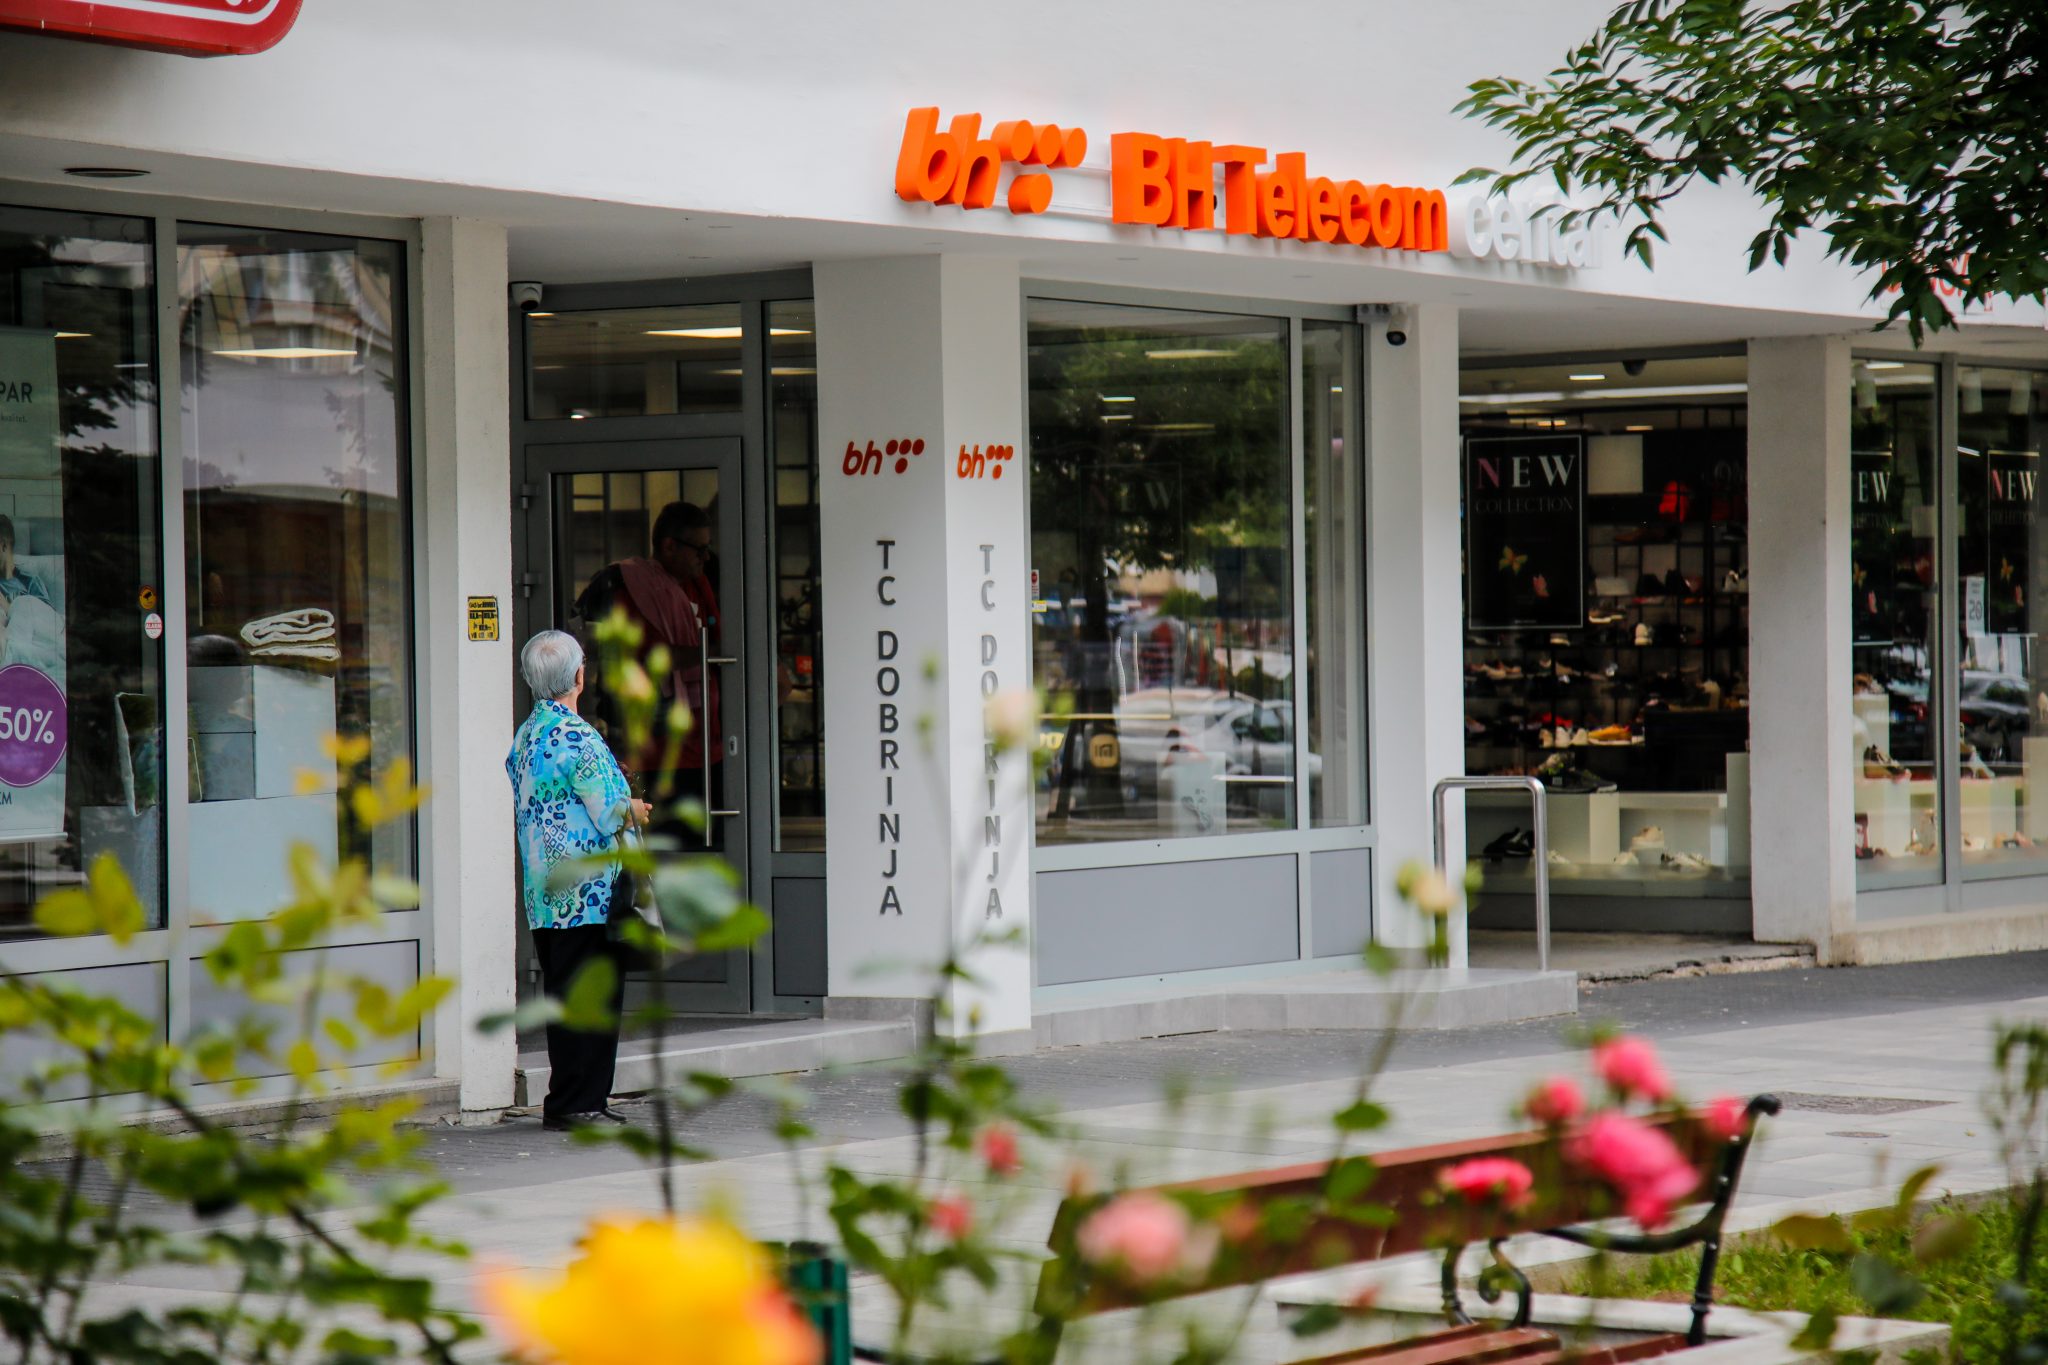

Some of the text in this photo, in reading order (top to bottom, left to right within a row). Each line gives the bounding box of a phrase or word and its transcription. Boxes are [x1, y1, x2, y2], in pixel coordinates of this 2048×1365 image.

[1477, 455, 1576, 489] NEW
[1991, 469, 2037, 500] NEW
[1474, 496, 1575, 514] COLLECTION
[979, 544, 997, 611] TC
[0, 706, 55, 744] 50%
[876, 539, 903, 915] TC DOBRINJA
